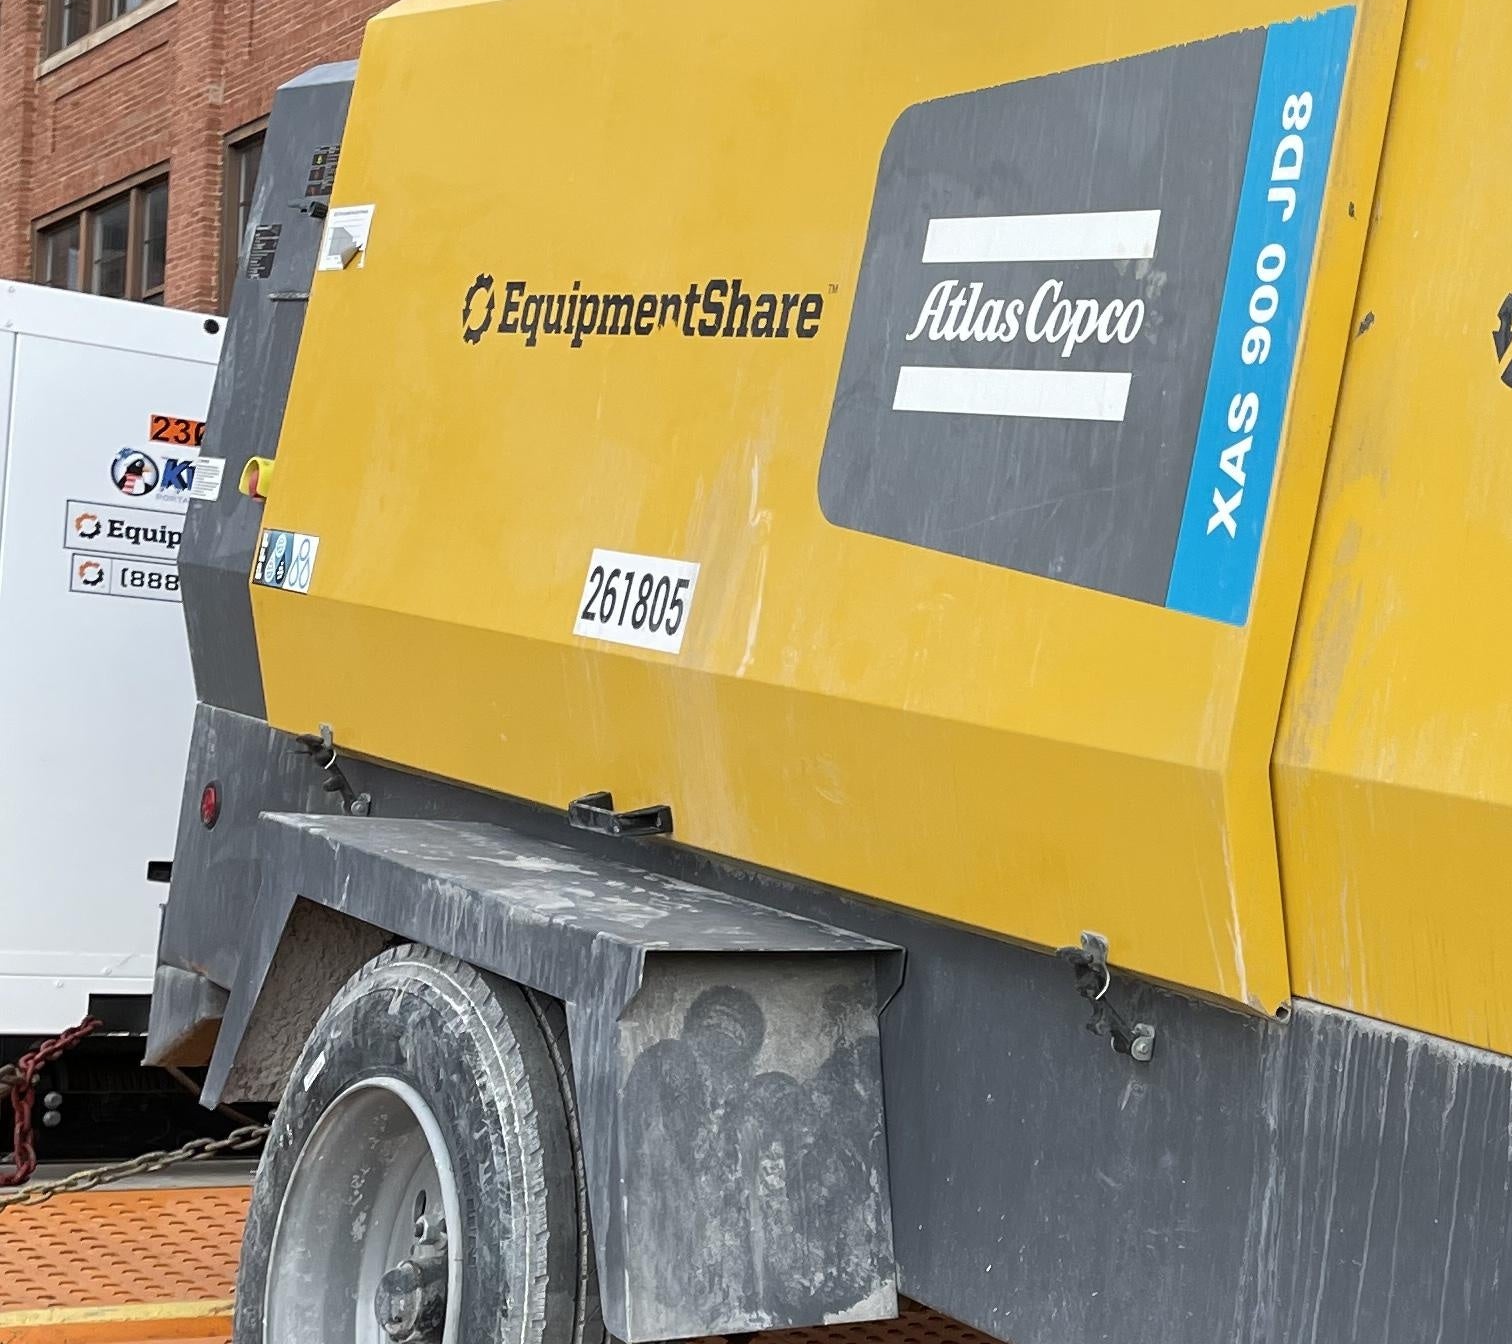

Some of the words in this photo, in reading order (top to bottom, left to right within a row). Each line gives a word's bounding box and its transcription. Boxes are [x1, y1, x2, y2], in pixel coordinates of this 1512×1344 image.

[497, 279, 825, 348] EquipmentShare
[905, 279, 1024, 342] Atlas
[1025, 279, 1145, 357] Copco
[1207, 392, 1260, 539] XAS
[1241, 243, 1287, 365] 900
[1267, 91, 1313, 222] JD8
[121, 568, 179, 591] (888
[581, 567, 691, 636] 261805
